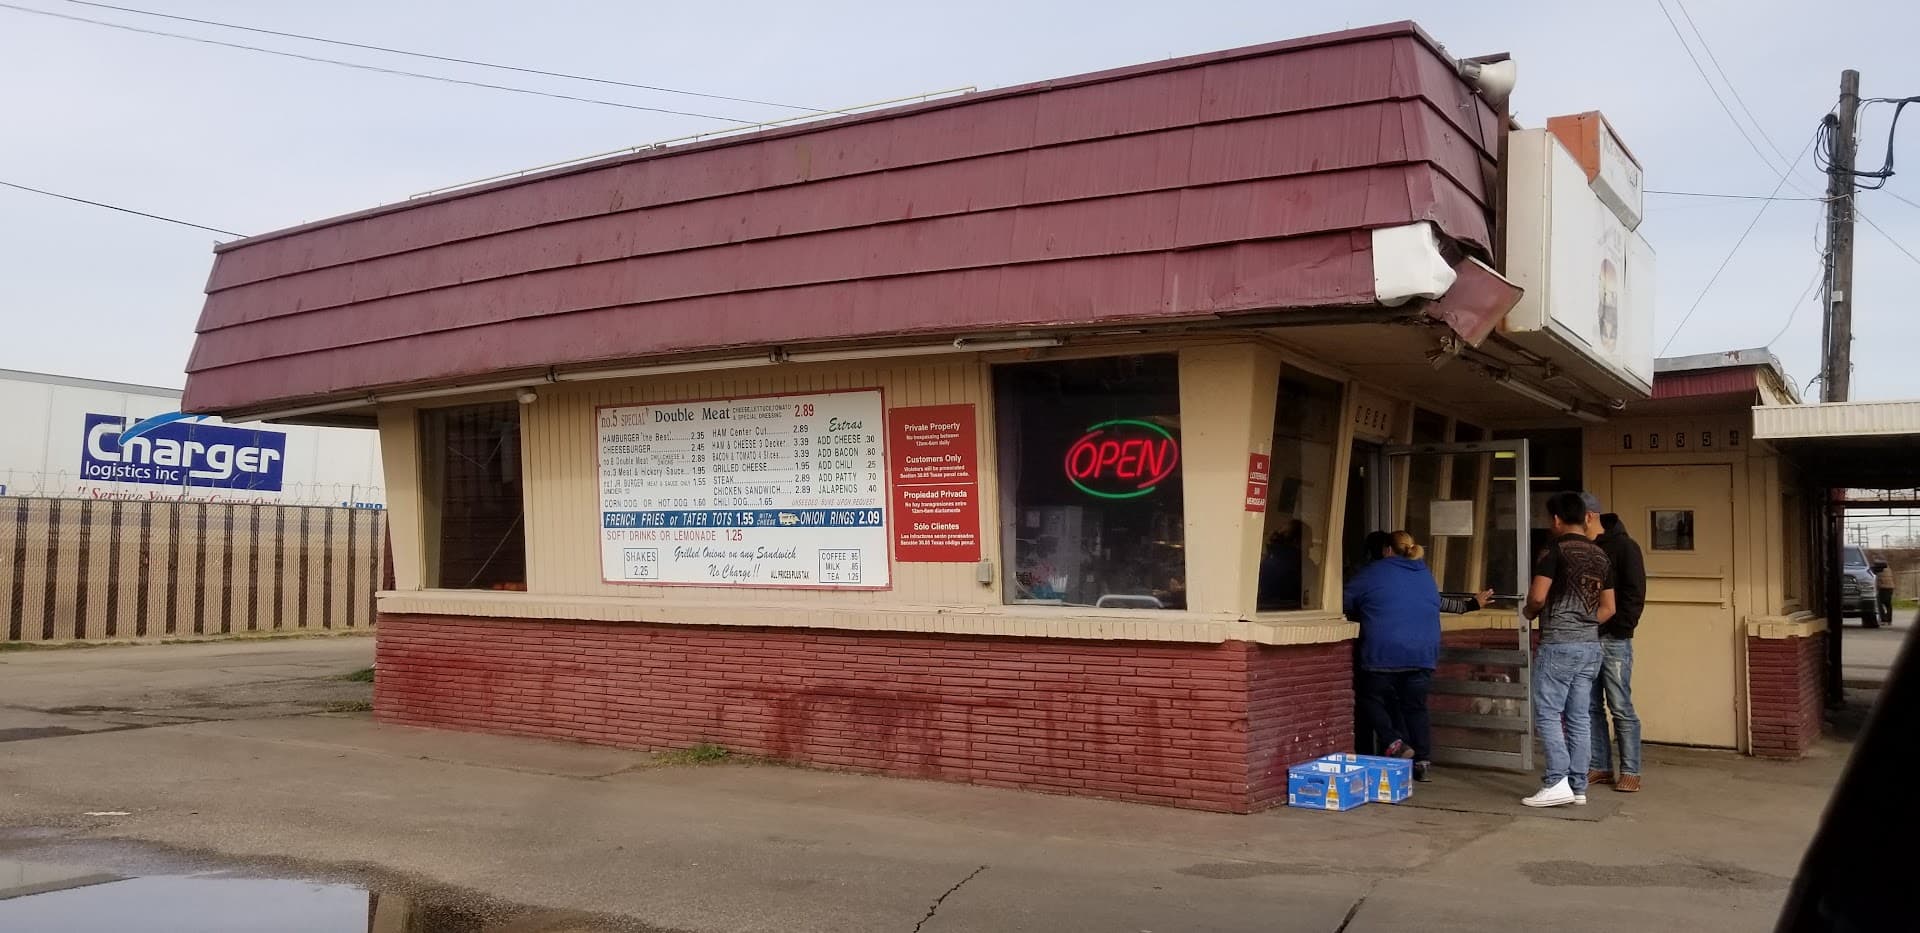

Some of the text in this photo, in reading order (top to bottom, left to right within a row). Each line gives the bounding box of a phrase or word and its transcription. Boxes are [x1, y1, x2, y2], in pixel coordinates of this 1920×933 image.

[655, 408, 694, 423] Double
[702, 407, 731, 420] Meat
[794, 403, 815, 418] 2.89
[828, 417, 862, 432] Extras
[904, 422, 961, 432] Private Property
[712, 424, 809, 438] HAM Center Cut 2.89
[602, 433, 640, 443] HAMBURGER
[690, 431, 705, 440] 2.35
[817, 435, 832, 445] ADD
[834, 434, 861, 445] CHEESE
[711, 440, 725, 449] HAM
[733, 439, 757, 449] CHEESE
[764, 438, 786, 448] Decker
[793, 437, 809, 447] 3.39
[87, 421, 281, 480] Charger
[602, 445, 651, 454] CHEESEBURGER
[793, 449, 810, 458] 3.39
[817, 448, 832, 458] ADD
[834, 447, 859, 457] BACON
[691, 454, 706, 463] 2.89
[906, 454, 962, 464] Customers Only
[1071, 439, 1168, 479] OPEN
[85, 461, 179, 481] logistics inc
[618, 468, 632, 476] Meat
[666, 467, 684, 476] Sauce
[693, 466, 706, 475] 1.95
[712, 461, 810, 473] GRILLED CHEESE 1.95
[818, 460, 832, 471] ADD
[835, 460, 853, 469] CHILI
[693, 477, 706, 486] 1.55
[713, 474, 811, 485] STEAK 2.89
[818, 473, 833, 483] ADD
[835, 472, 857, 482] PATTY
[713, 485, 811, 496] CHICKEN SANDWICH 2.89
[818, 483, 858, 494] JALAPENOS
[903, 490, 967, 500] Propiedad Privada
[623, 499, 638, 508] DOG
[658, 498, 671, 507] HOT
[673, 498, 688, 507] DOG
[733, 498, 748, 506] DOG
[605, 511, 754, 527] FRENCH FRIES or TATER TOTS 1.55
[800, 510, 880, 525] ONION RINGS 2.09
[914, 522, 960, 531] Sólo Clientes
[606, 529, 743, 542] SOFT DRINKS OR LEMONADE 1.25
[625, 551, 657, 562] SHAKES
[673, 545, 798, 563] Grilled Onions on any Sandwich
[821, 552, 847, 561] COFFEE
[634, 565, 649, 576] 2.25
[708, 563, 720, 577] No
[825, 562, 840, 571] MILK
[826, 572, 840, 581] TEA
